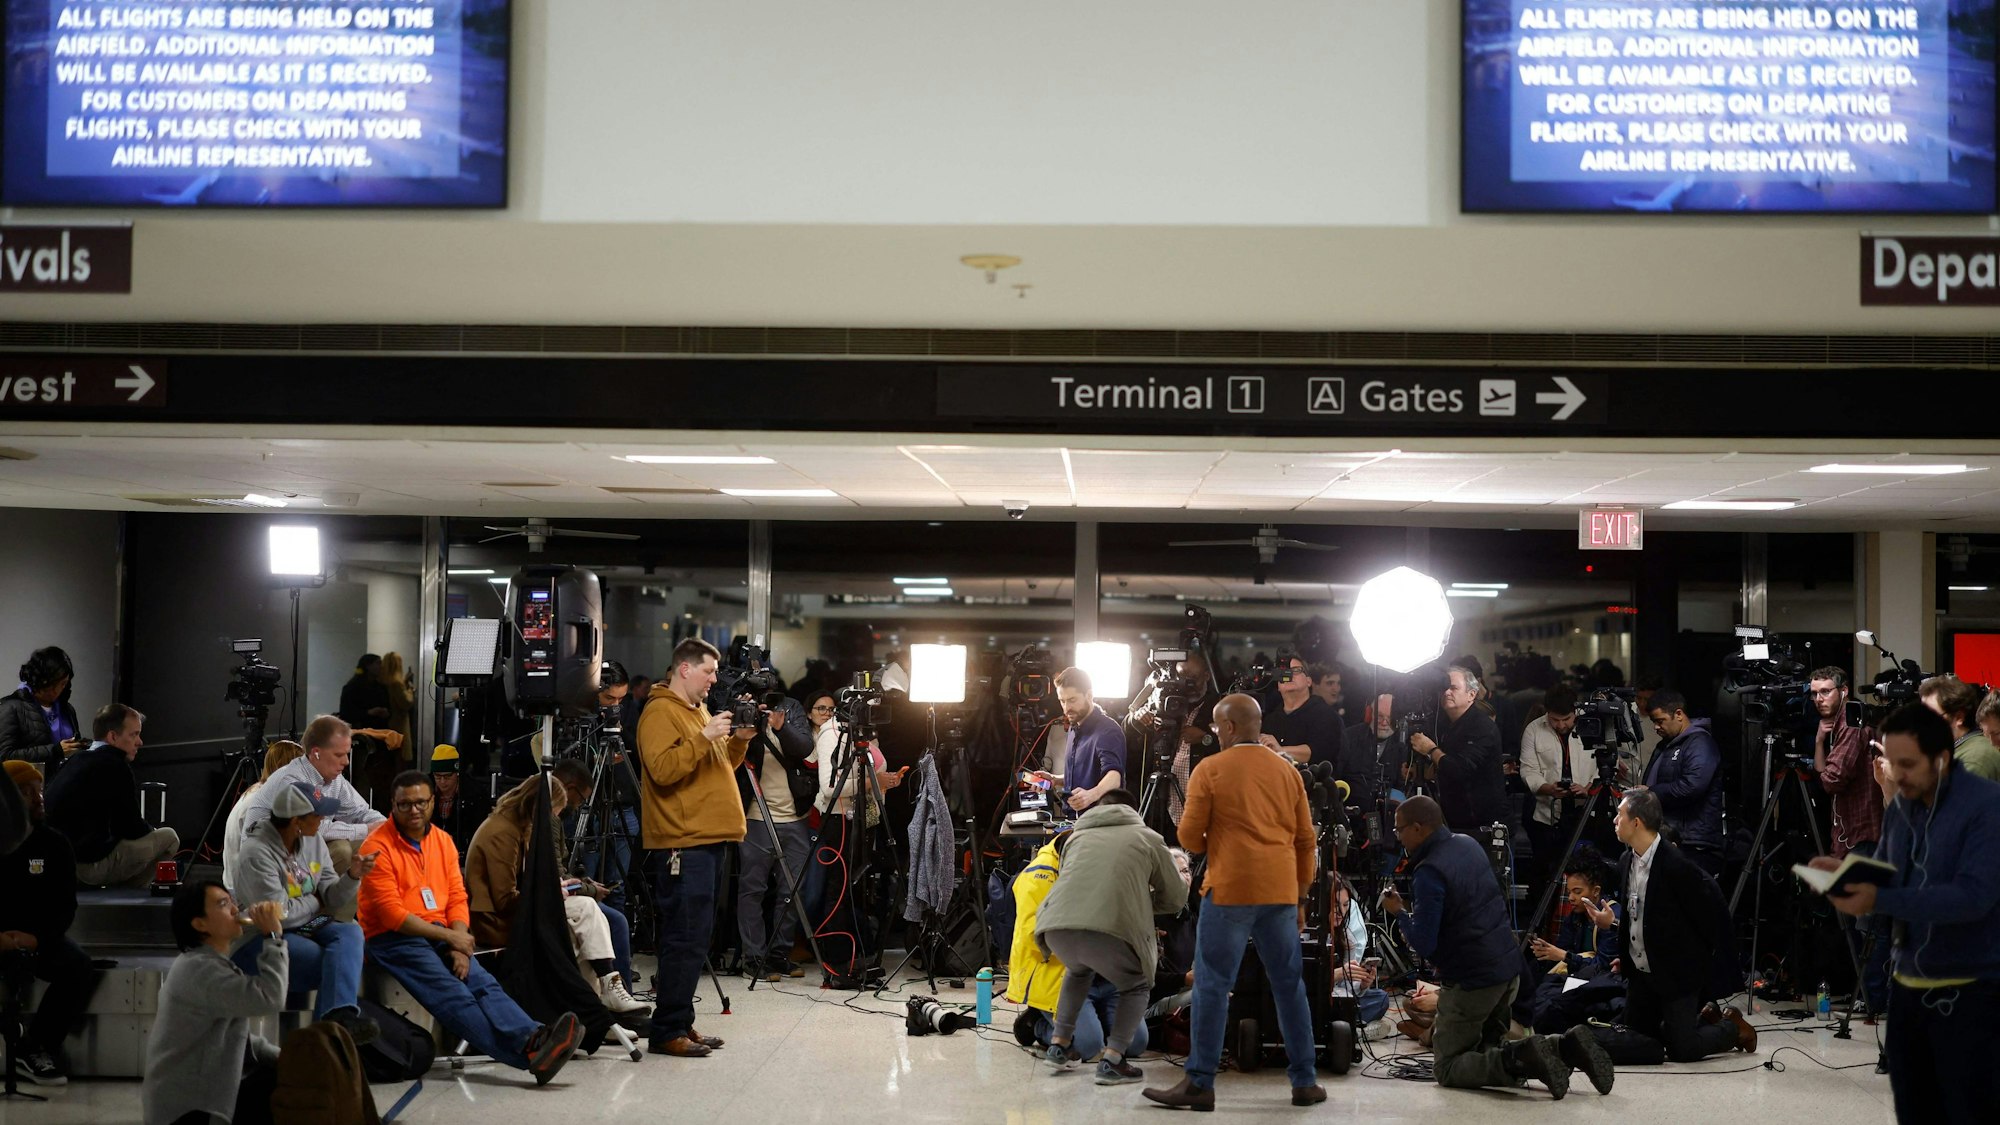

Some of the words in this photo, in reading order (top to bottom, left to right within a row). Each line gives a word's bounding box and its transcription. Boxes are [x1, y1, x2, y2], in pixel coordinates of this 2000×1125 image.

[57, 7, 96, 28] ALL
[100, 7, 183, 28] FLIGHTS
[185, 7, 226, 28] ARE
[229, 7, 293, 28] BEING
[297, 7, 352, 28] HELD
[355, 7, 389, 28] ON
[392, 7, 434, 28] THE
[1519, 8, 1561, 29] ALL
[1565, 8, 1653, 29] FLIGHTS
[1656, 8, 1698, 29] ARE
[1702, 8, 1770, 29] BEING
[1774, 8, 1832, 29] HELD
[1835, 8, 1871, 29] ON
[1875, 8, 1918, 29] THE
[55, 35, 150, 56] AIRFIELD.
[154, 35, 281, 56] ADDITIONAL
[285, 35, 434, 56] INFORMATION
[1518, 36, 1620, 58] AIRFIELD.
[1623, 36, 1758, 58] ADDITIONAL
[1763, 36, 1919, 58] INFORMATION
[56, 62, 107, 84] WILL
[111, 62, 137, 84] BE
[140, 62, 250, 84] AVAILABLE
[253, 62, 280, 84] AS
[284, 62, 304, 84] IT
[308, 62, 327, 84] IS
[330, 62, 433, 84] RECEIVED.
[1519, 64, 1574, 86] WILL
[1577, 64, 1606, 86] BE
[1608, 64, 1725, 86] AVAILABLE
[1728, 64, 1758, 86] AS
[1762, 64, 1782, 86] IT
[1787, 64, 1806, 86] IS
[1811, 64, 1917, 86] RECEIVED.
[81, 90, 122, 112] FOR
[126, 90, 248, 112] CUSTOMERS
[252, 90, 285, 112] ON
[289, 90, 407, 112] DEPARTING
[1547, 93, 1591, 115] FOR
[1594, 93, 1725, 115] CUSTOMERS
[1728, 93, 1763, 115] ON
[1768, 93, 1891, 115] DEPARTING
[65, 117, 153, 140] FLIGHTS,
[158, 117, 230, 140] PLEASE
[233, 117, 301, 140] CHECK
[304, 117, 358, 140] WITH
[362, 117, 422, 140] YOUR
[1530, 121, 1624, 144] FLIGHTS,
[1628, 121, 1705, 144] PLEASE
[1709, 121, 1780, 144] CHECK
[1783, 121, 1841, 144] WITH
[1846, 121, 1908, 144] YOUR
[111, 145, 193, 167] AIRLINE
[197, 145, 372, 167] REPRESENTATIVE.
[1580, 150, 1666, 172] AIRLINE
[1671, 150, 1856, 172] REPRESENTATIVE.
[0, 230, 91, 282] vals
[1873, 238, 2000, 301] Depa
[1051, 377, 1213, 409] Terminal
[1239, 381, 1251, 408] 1
[1313, 382, 1339, 409] A
[1360, 380, 1464, 412] Gates
[1591, 513, 1635, 545] EXIT
